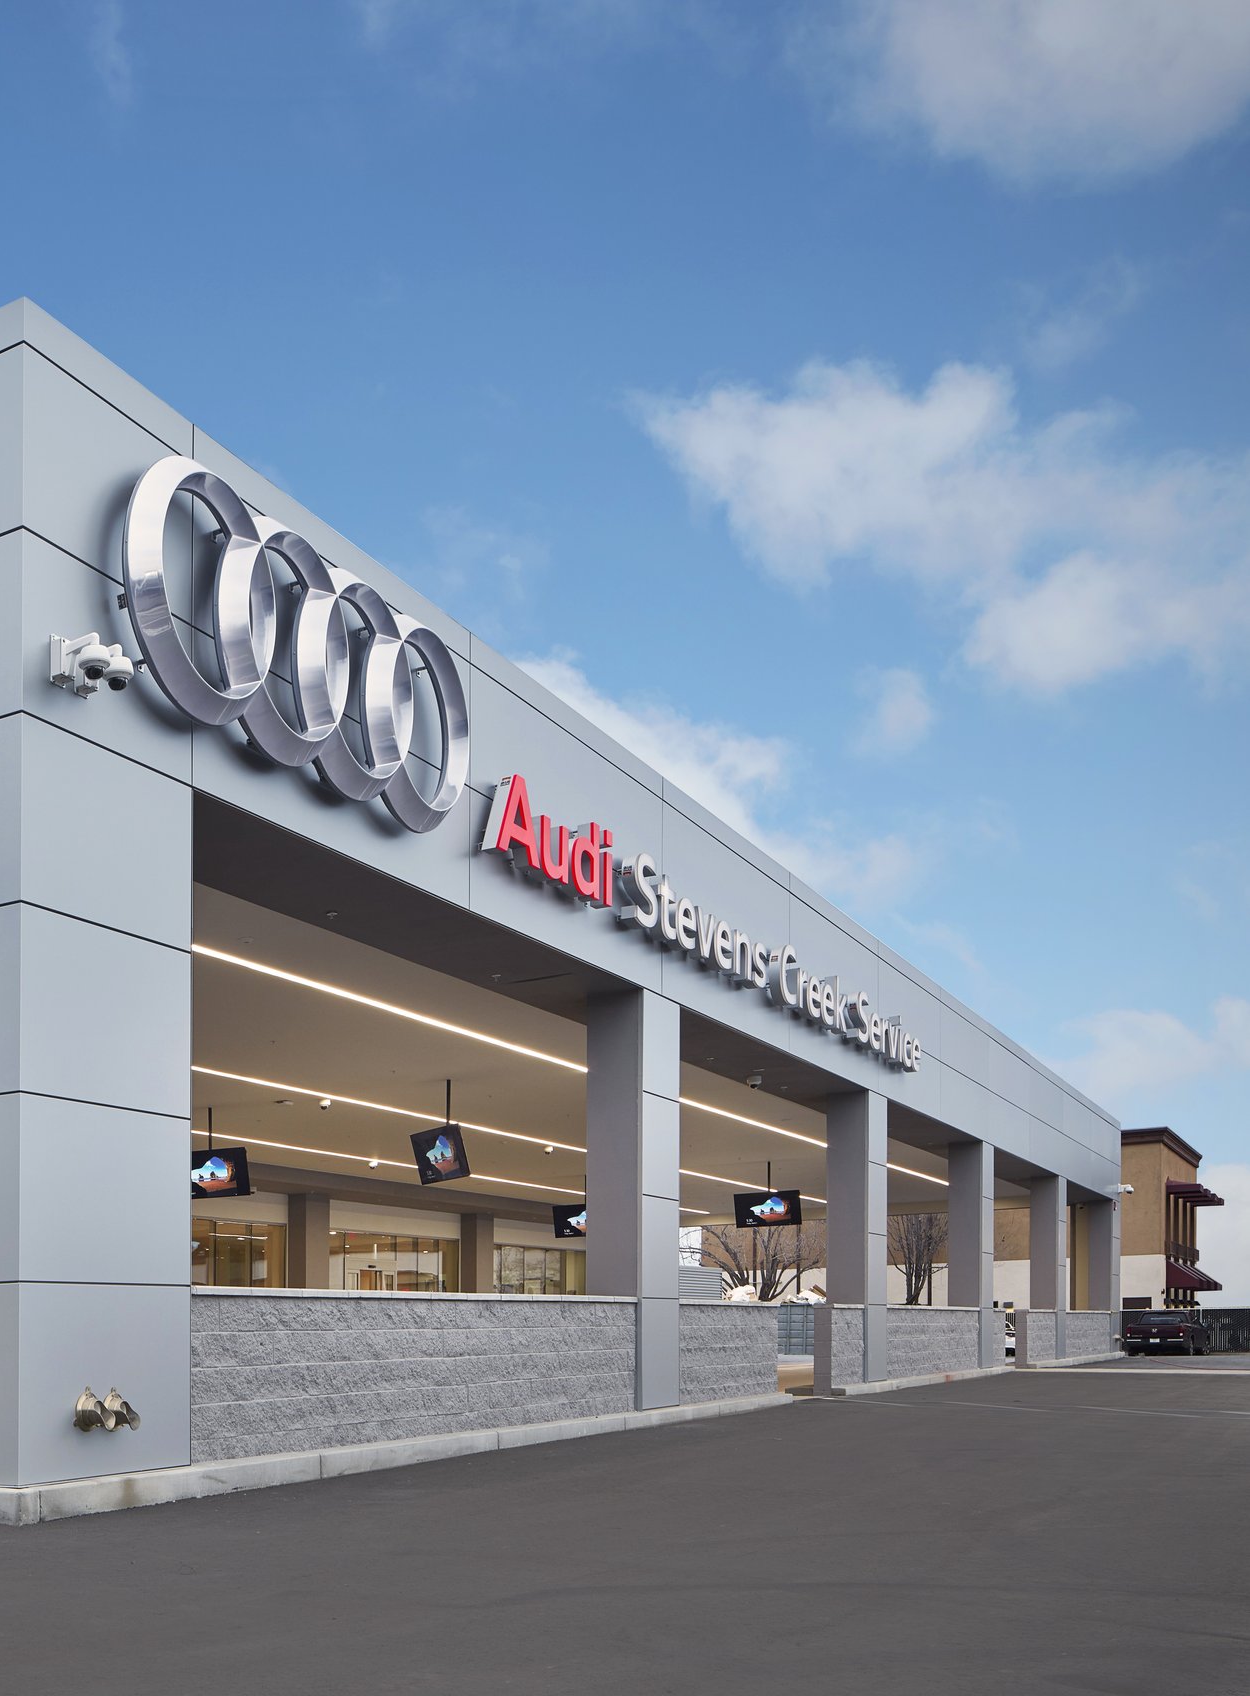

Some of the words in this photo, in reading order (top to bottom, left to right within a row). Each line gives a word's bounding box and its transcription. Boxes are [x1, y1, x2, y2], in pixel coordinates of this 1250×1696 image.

[482, 774, 613, 907] Audi
[620, 853, 768, 989] Stevens
[770, 945, 848, 1035] Creek
[846, 991, 922, 1072] Service
